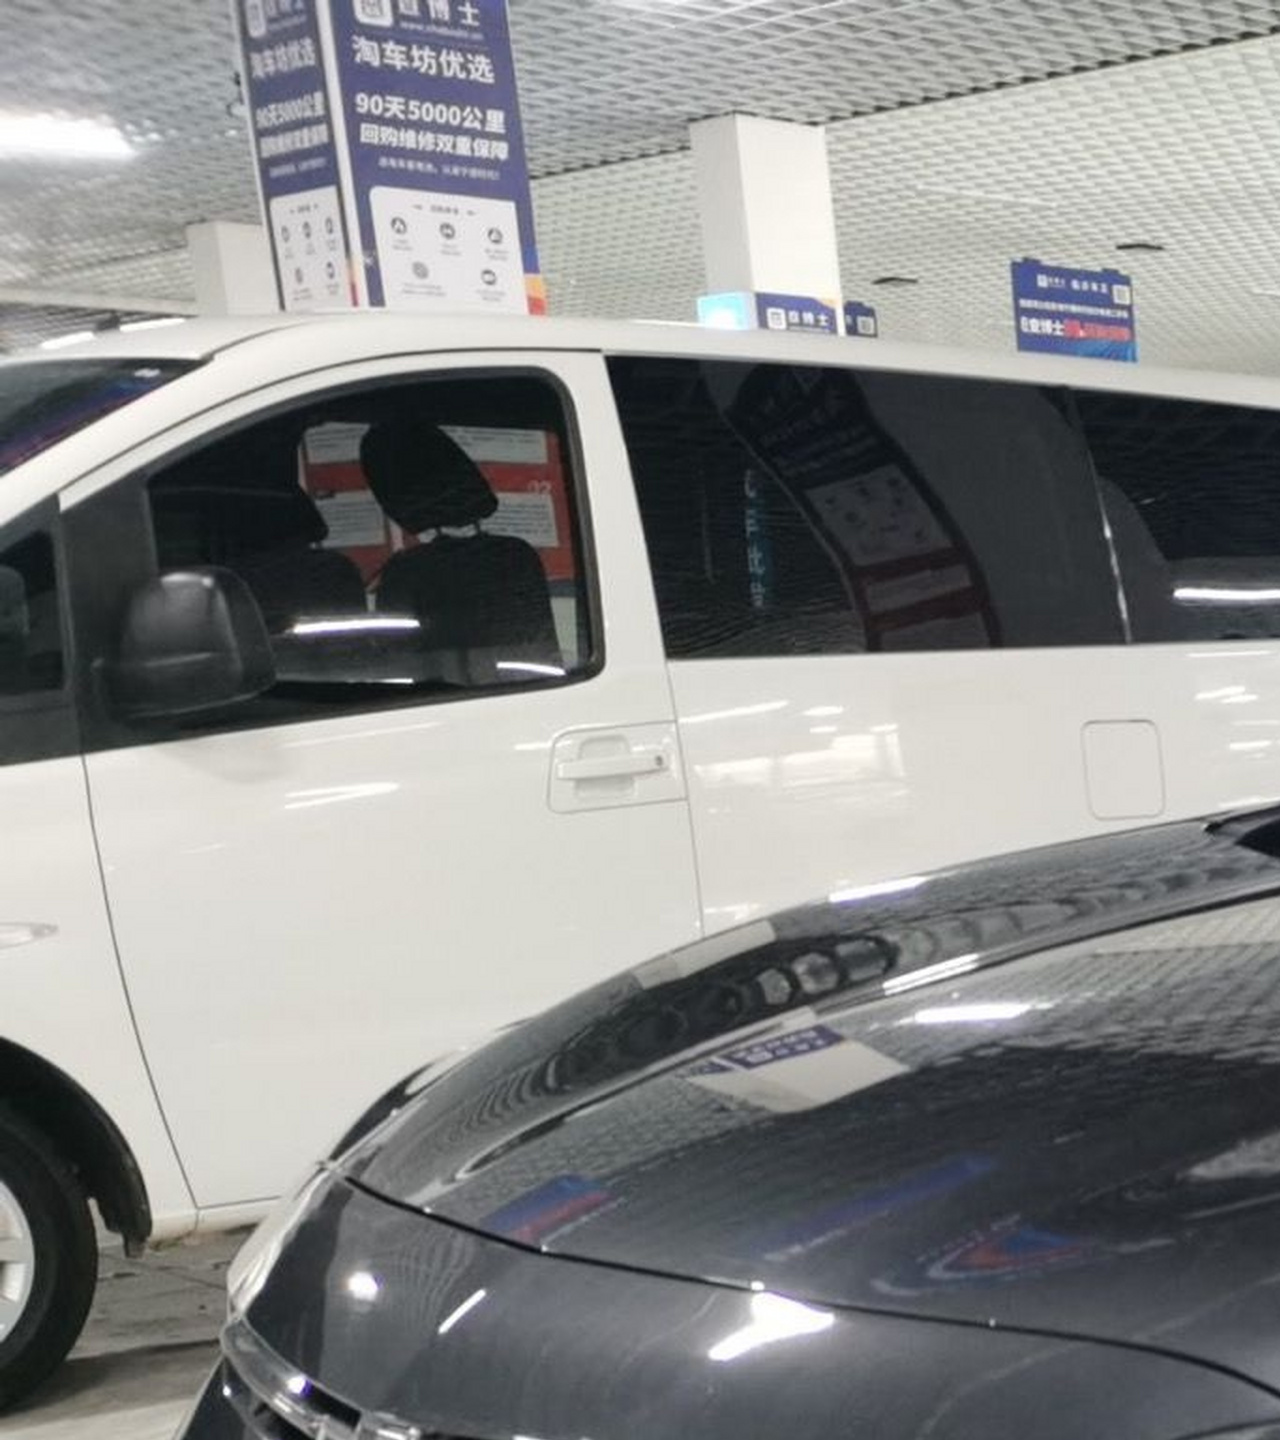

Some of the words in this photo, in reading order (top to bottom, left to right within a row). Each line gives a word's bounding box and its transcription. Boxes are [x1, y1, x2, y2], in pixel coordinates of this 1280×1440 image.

[352, 35, 496, 84] 淘车坊优选
[355, 93, 506, 134] 90天5000公里
[359, 122, 509, 162] 回购维修双重保障
